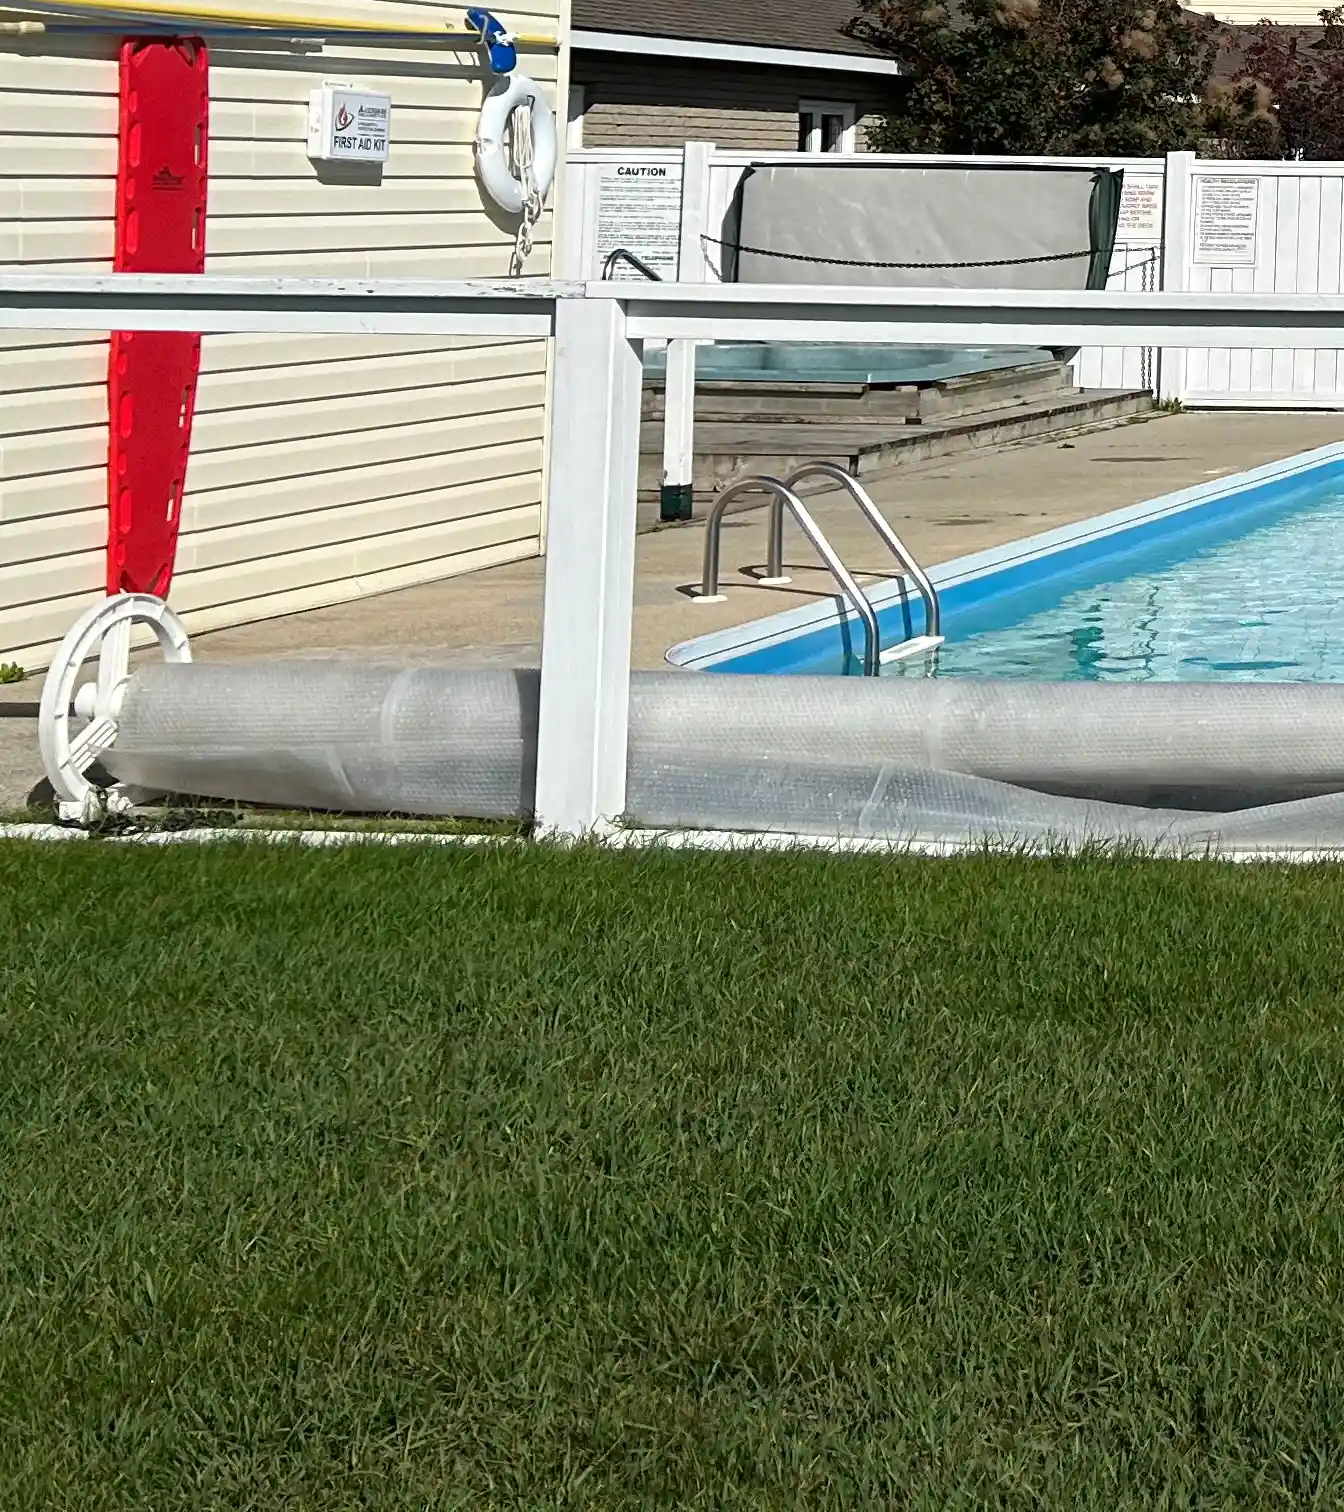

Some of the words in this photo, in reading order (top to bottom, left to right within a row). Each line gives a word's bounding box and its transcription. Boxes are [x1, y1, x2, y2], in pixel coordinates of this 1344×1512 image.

[333, 136, 357, 149] FIRST
[358, 138, 371, 150] AID
[373, 139, 386, 151] KIT
[617, 167, 666, 176] CAUTION
